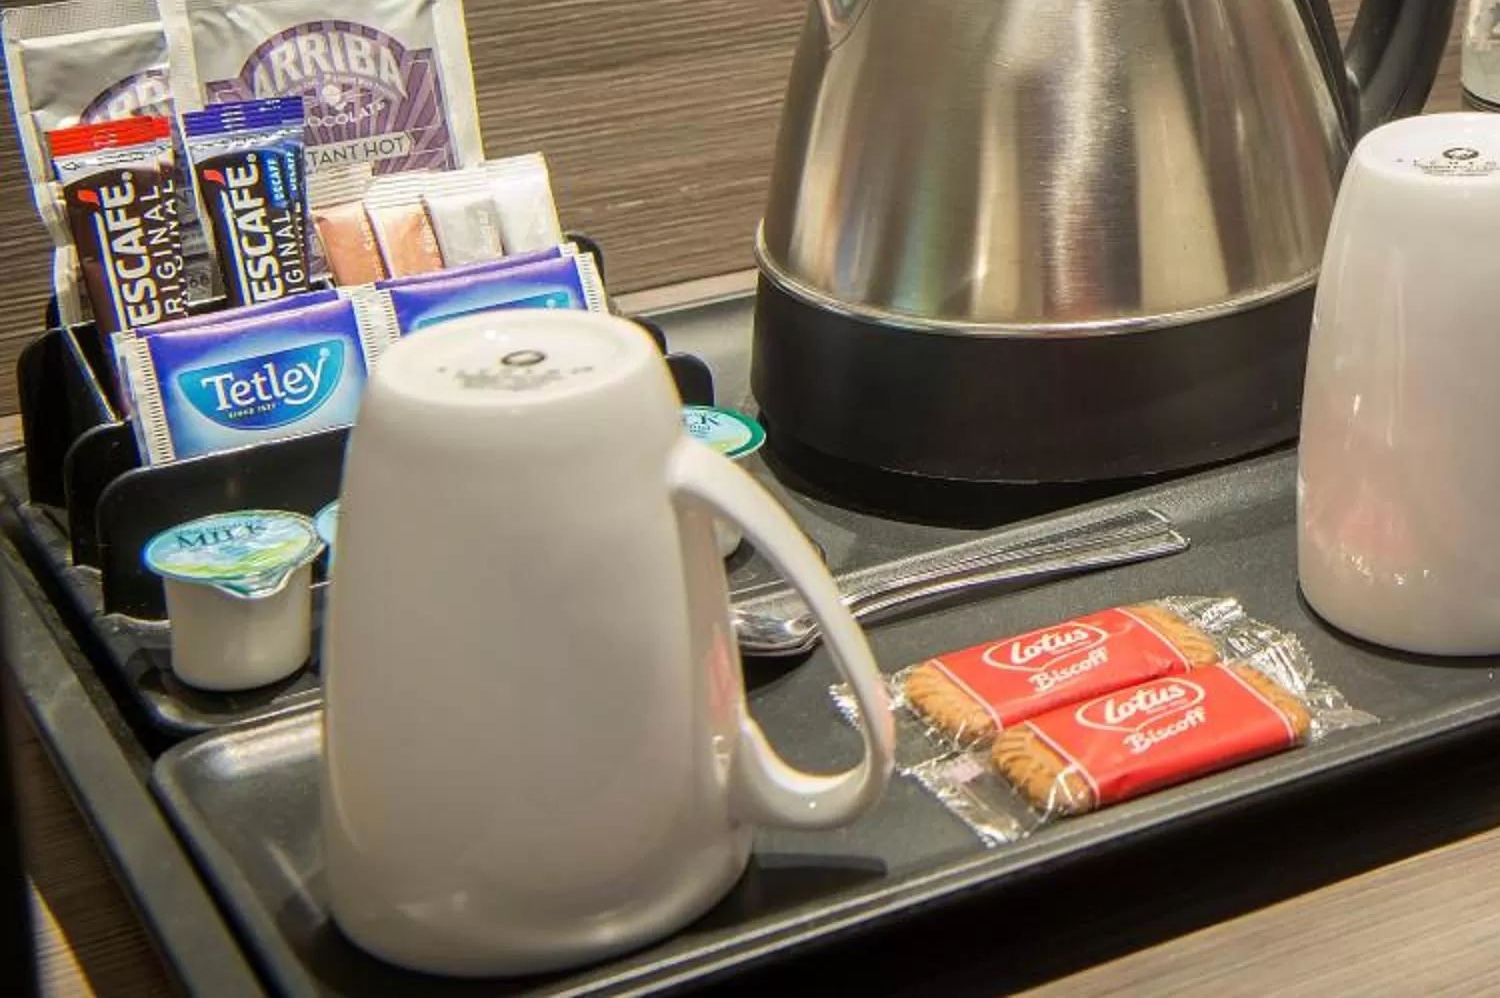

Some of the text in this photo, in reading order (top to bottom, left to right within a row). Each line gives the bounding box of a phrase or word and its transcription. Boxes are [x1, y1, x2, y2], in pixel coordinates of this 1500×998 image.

[252, 30, 408, 101] ARRIBA
[305, 101, 386, 128] OCOLATE
[306, 135, 406, 167] TANT HOT
[78, 173, 162, 327] ESCAFÉ
[139, 184, 184, 315] RIGINAL
[204, 157, 283, 304] ESCAFÉ
[272, 206, 306, 294] IGINAL
[202, 346, 331, 413] Tetley
[1011, 629, 1090, 665] Lotus
[1028, 646, 1109, 693] Biscoff
[1104, 684, 1187, 725] Lotus
[1123, 706, 1206, 755] Biscoff
